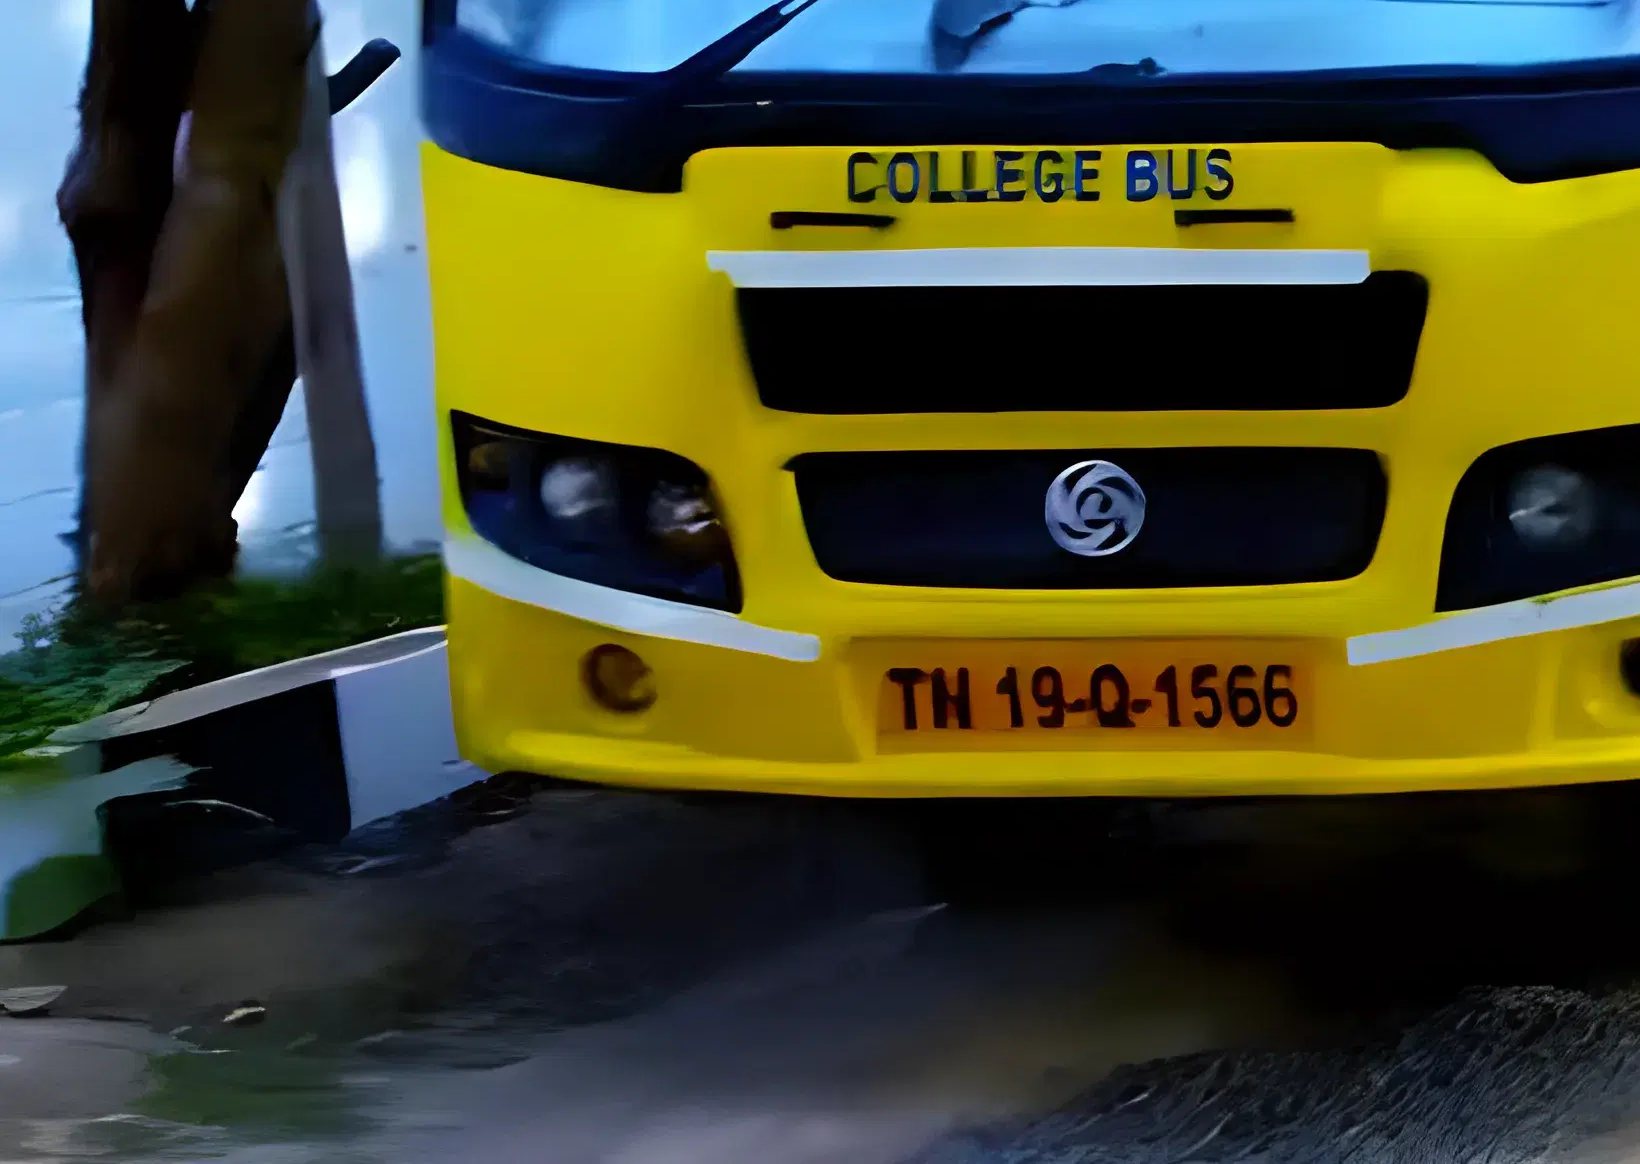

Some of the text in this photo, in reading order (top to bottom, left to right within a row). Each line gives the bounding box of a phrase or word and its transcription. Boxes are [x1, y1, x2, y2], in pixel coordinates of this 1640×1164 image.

[847, 148, 1235, 204] COLLEGE BUS
[886, 663, 1299, 731] TN 19-Q-1566
